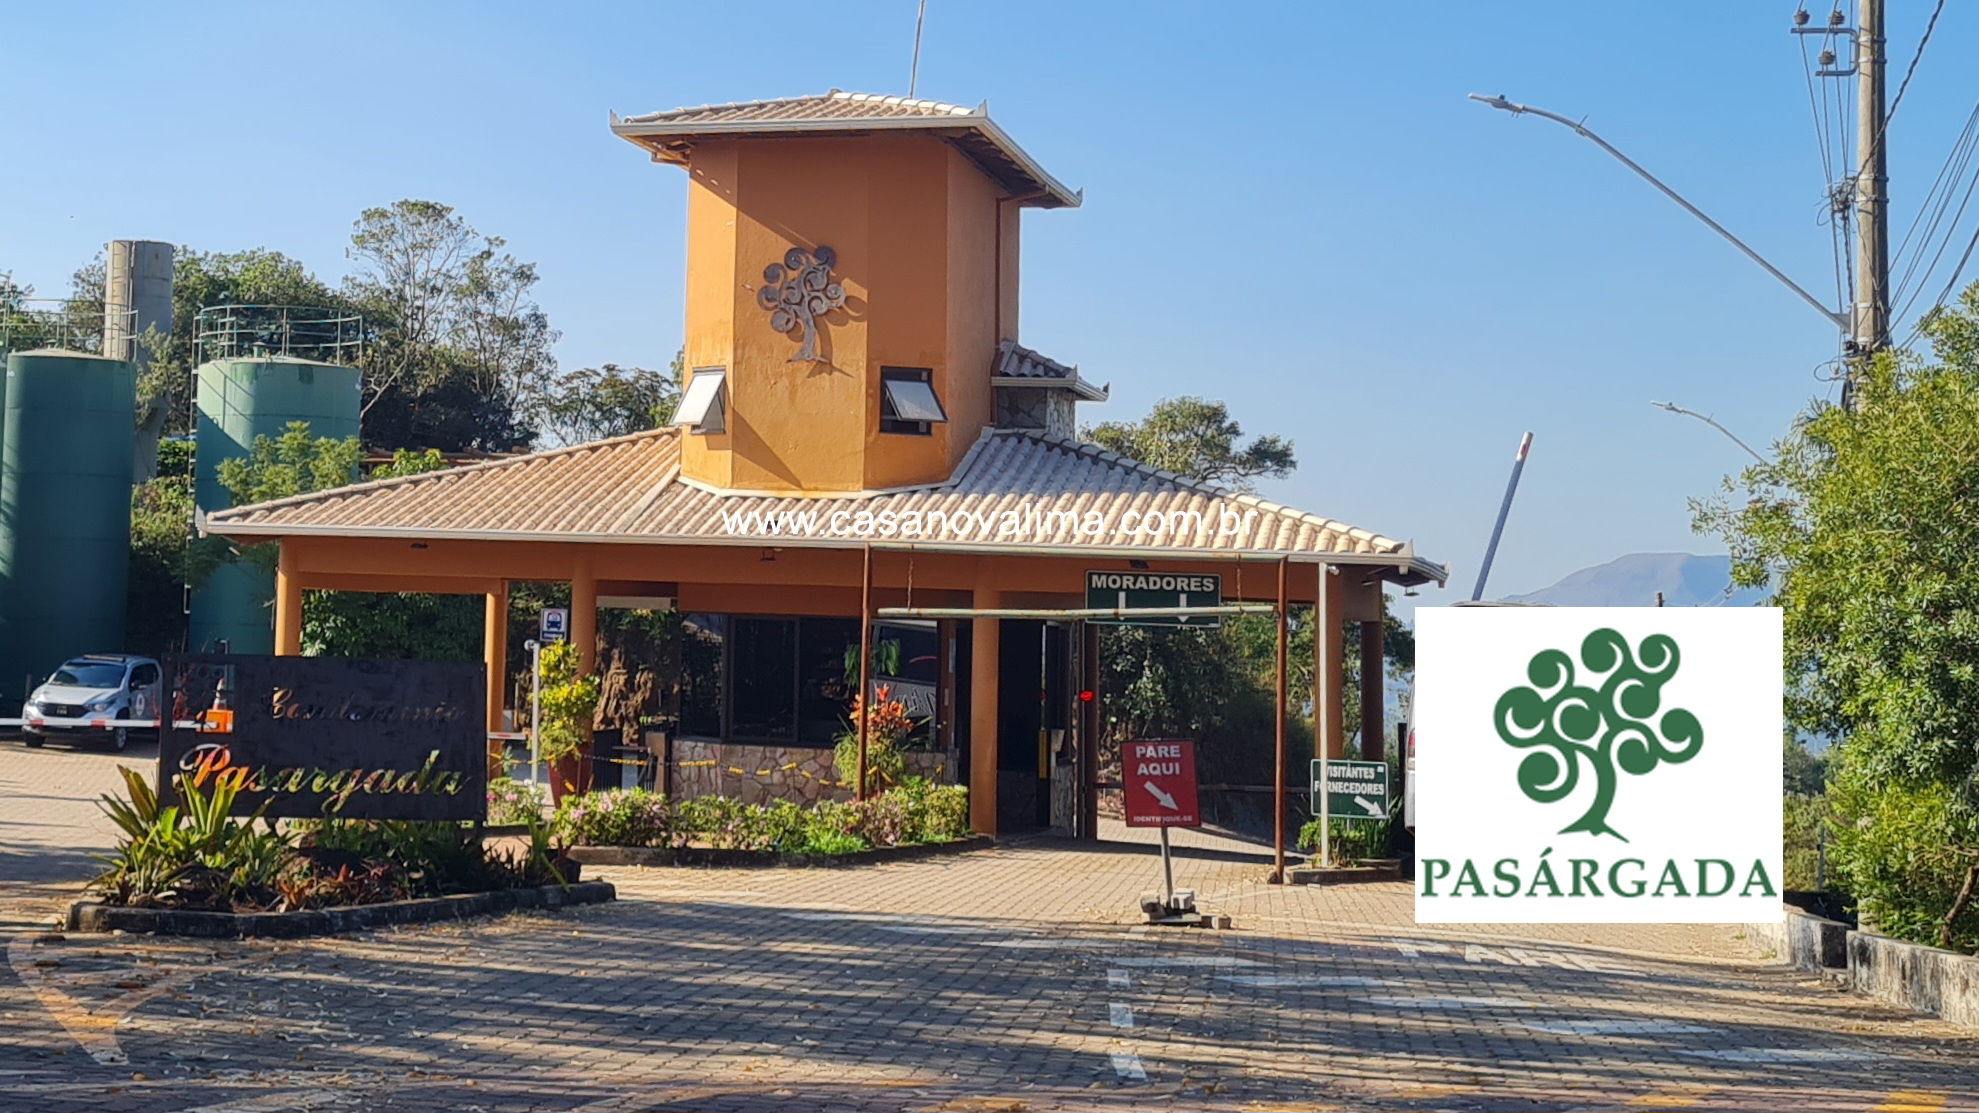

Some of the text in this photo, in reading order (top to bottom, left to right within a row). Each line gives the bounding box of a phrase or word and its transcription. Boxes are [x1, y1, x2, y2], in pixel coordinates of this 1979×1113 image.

[1091, 574, 1216, 592] MORADORES
[1135, 744, 1181, 758] PARE
[1137, 762, 1181, 776] AQUI
[1314, 780, 1385, 796] FRNECEDORES
